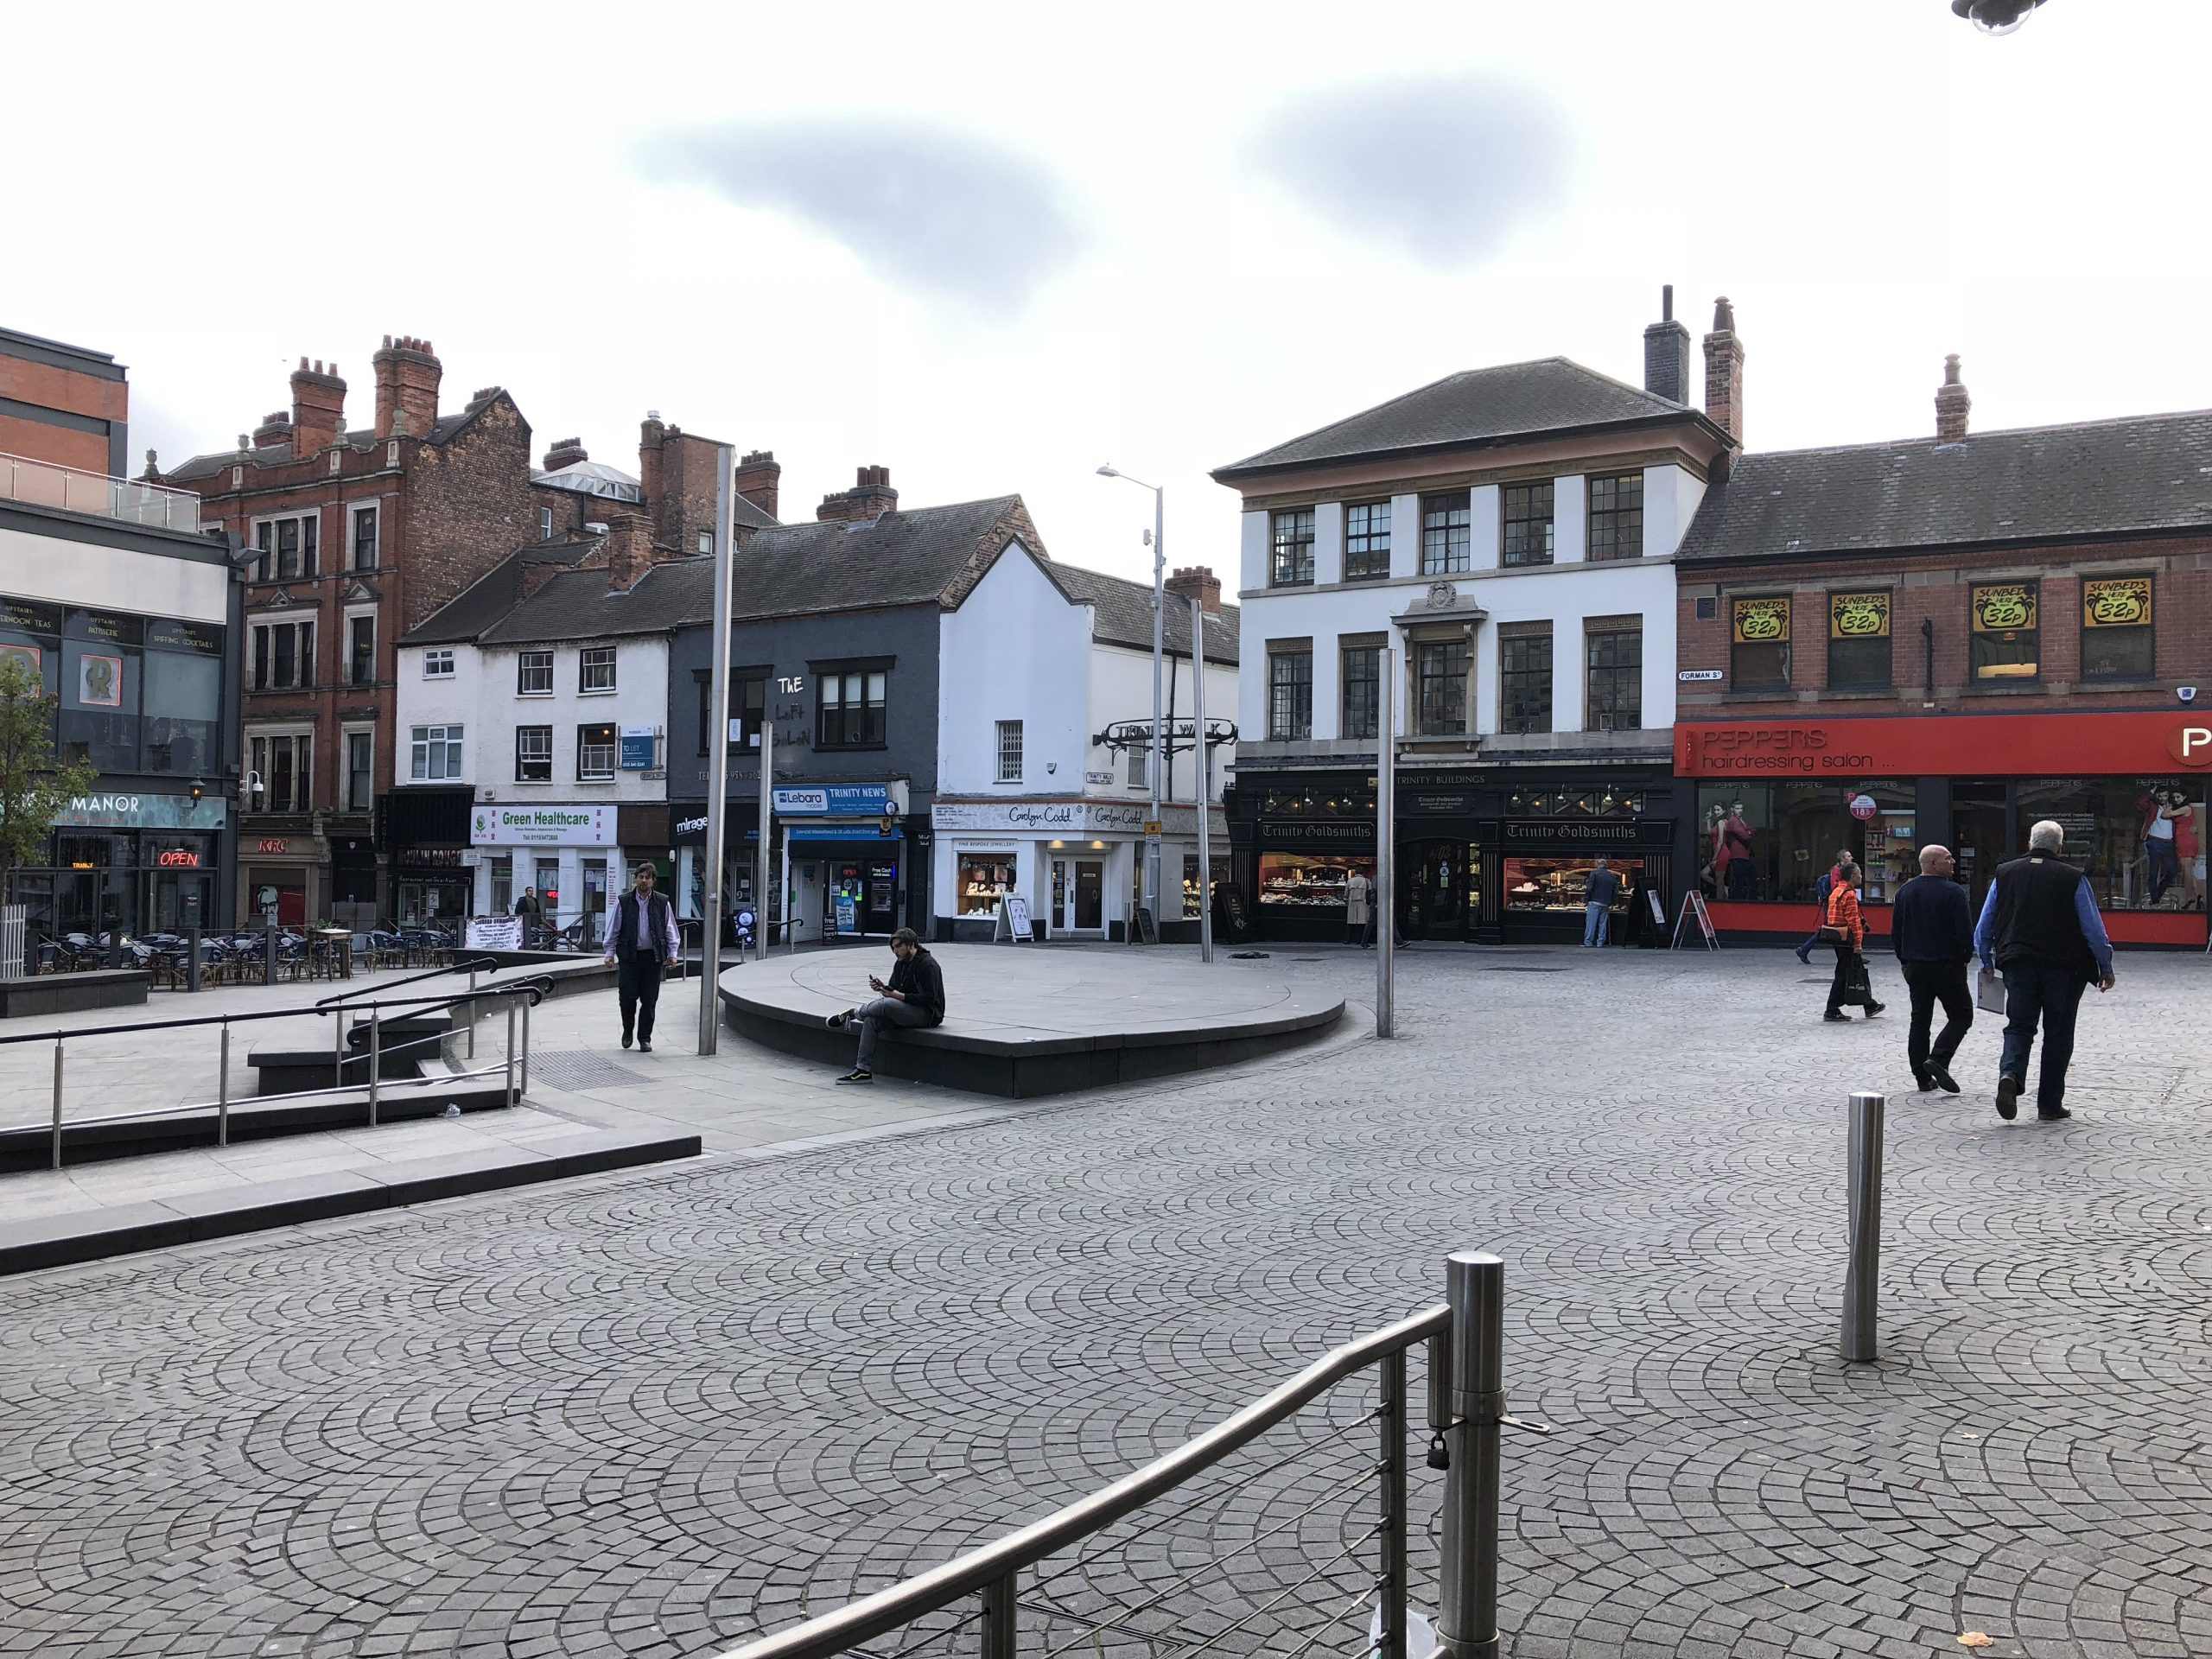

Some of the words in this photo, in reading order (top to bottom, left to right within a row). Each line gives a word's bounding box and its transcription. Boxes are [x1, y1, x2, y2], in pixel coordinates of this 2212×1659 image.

[1978, 588, 2025, 597] SUNBED
[2088, 581, 2147, 592] SUNBEDS
[1738, 601, 1786, 611] SUNBEDS
[1834, 594, 1885, 605] SUNBEDS
[5, 605, 33, 614] UPSTAIRS
[35, 619, 51, 628] TEAS
[88, 627, 118, 638] PATISSERIE
[153, 635, 178, 645] SPIFFING
[182, 639, 213, 648] COCKTAILS
[1178, 722, 1222, 735] WK
[1702, 728, 1827, 751] PEPPERS
[2183, 728, 2212, 757] P
[1702, 753, 1815, 772] hairdressing
[1822, 752, 1873, 768] salon
[1397, 776, 1430, 785] TRINITY
[1436, 775, 1485, 784] BUILDINGS
[787, 792, 822, 804] Lebara
[830, 787, 861, 798] TRINITY
[862, 787, 887, 798] NEWS
[72, 796, 139, 812] MANOR
[502, 811, 531, 825] Green
[534, 811, 589, 825] Healthcare
[1008, 806, 1044, 826] Carolyn
[1044, 806, 1072, 823] Codd
[1095, 807, 1122, 827] Carolyn
[1122, 809, 1142, 824] Codd
[1262, 824, 1302, 837] Trinity
[1305, 824, 1371, 838] Goldsmiths
[1507, 824, 1554, 837] Trinity
[1557, 824, 1636, 839] Goldsmiths
[259, 838, 287, 853] KFC
[160, 852, 198, 867] OPEN
